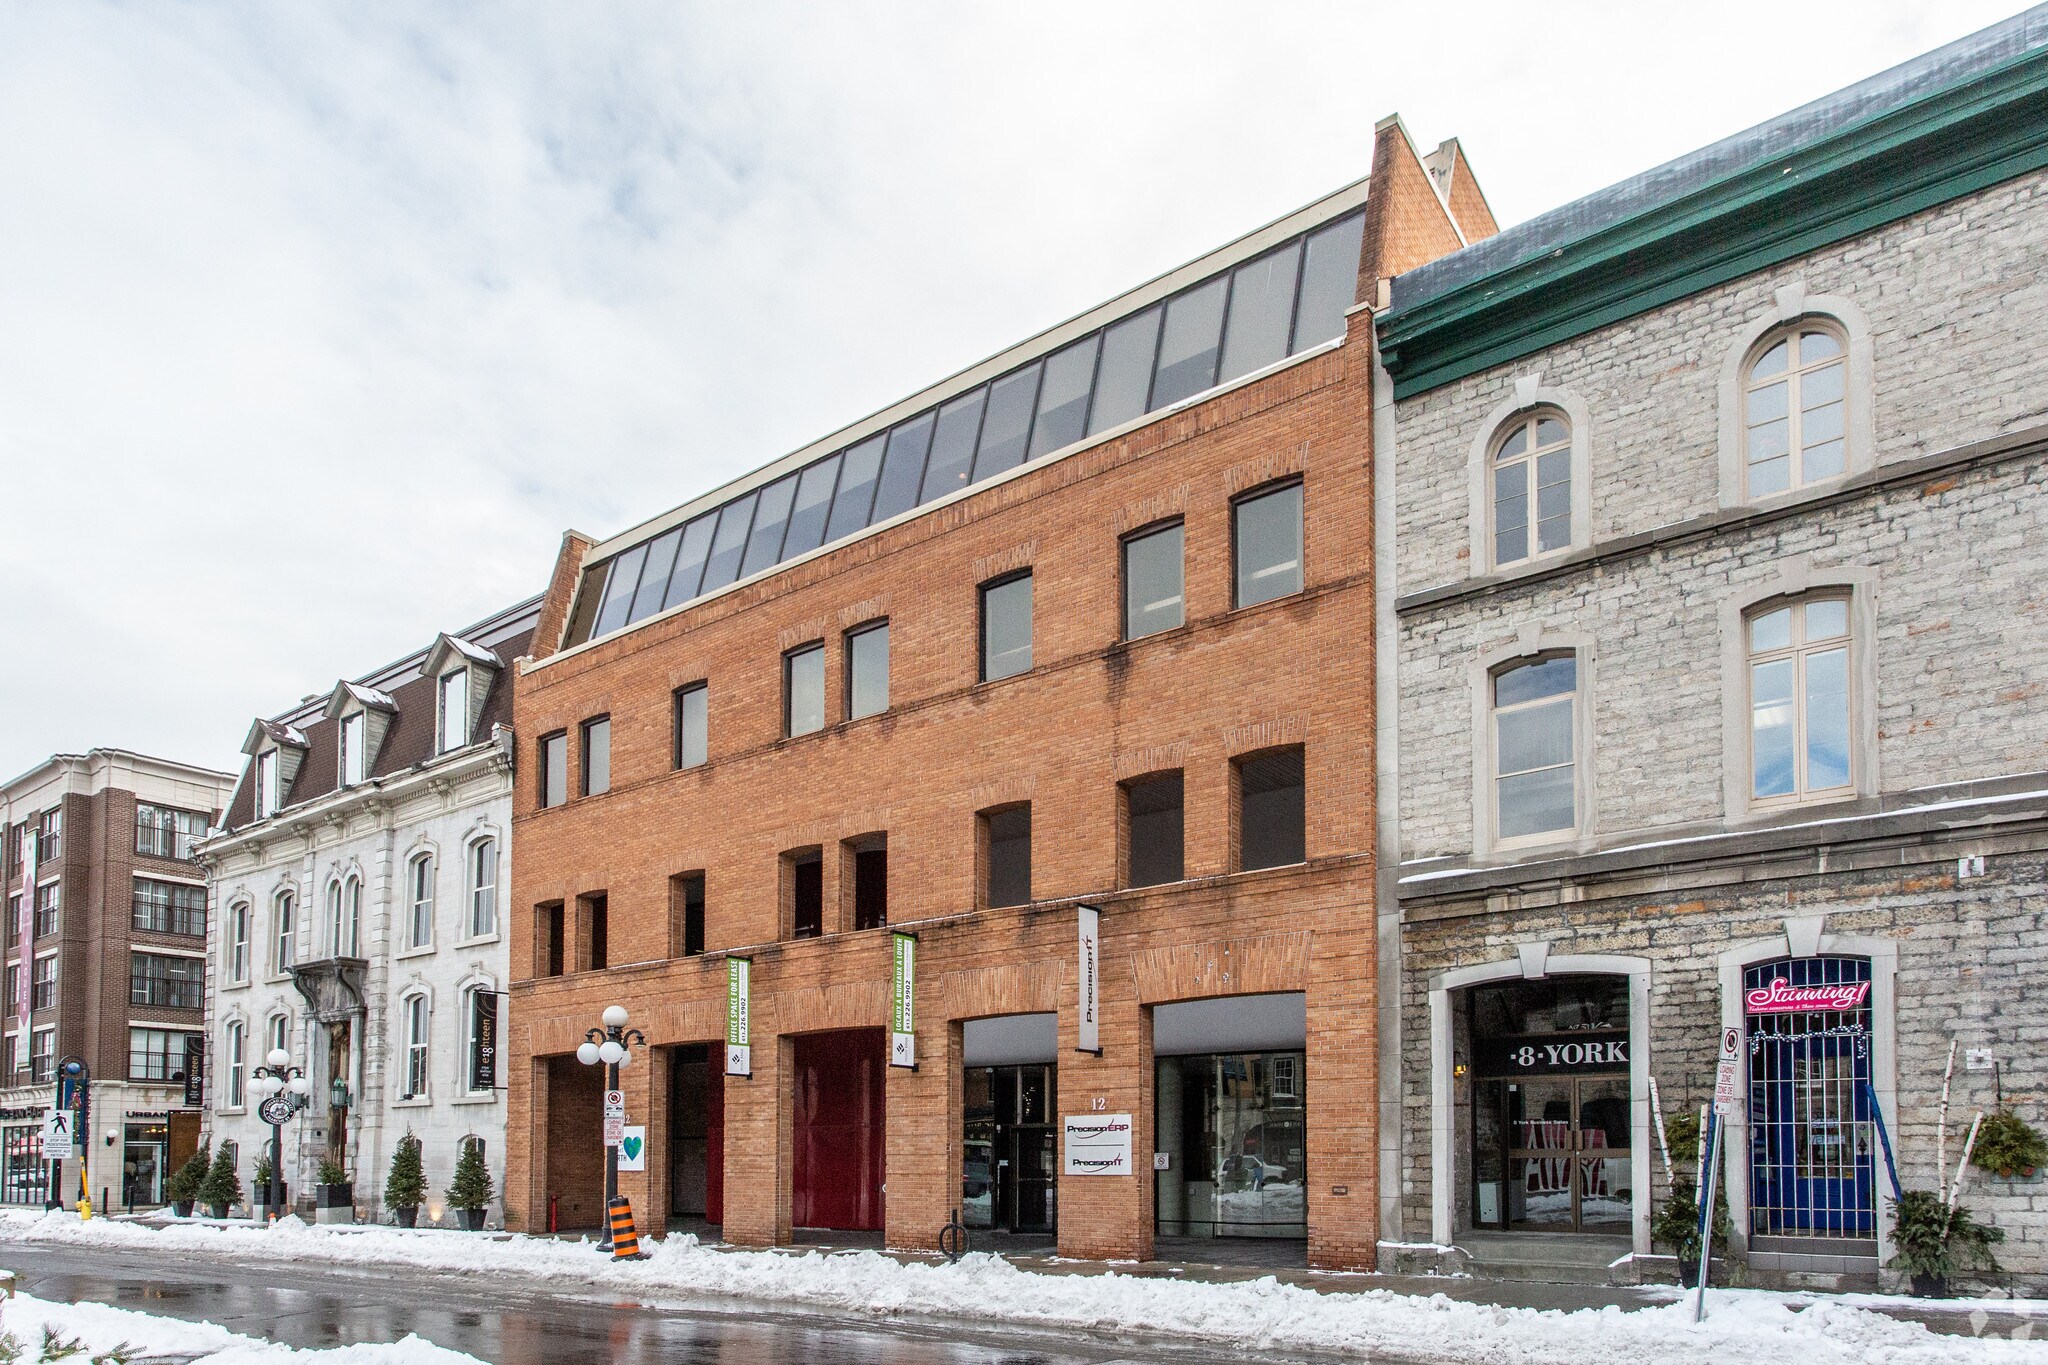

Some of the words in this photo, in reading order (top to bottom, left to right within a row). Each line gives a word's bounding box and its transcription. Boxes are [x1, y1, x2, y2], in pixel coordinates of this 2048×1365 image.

[1748, 978, 1870, 1008] Stunning!
[1721, 1074, 1732, 1083] ZONE
[1717, 1085, 1727, 1095] ZONE
[1091, 1097, 1106, 1111] 12
[1067, 1123, 1129, 1134] PrecisionERP
